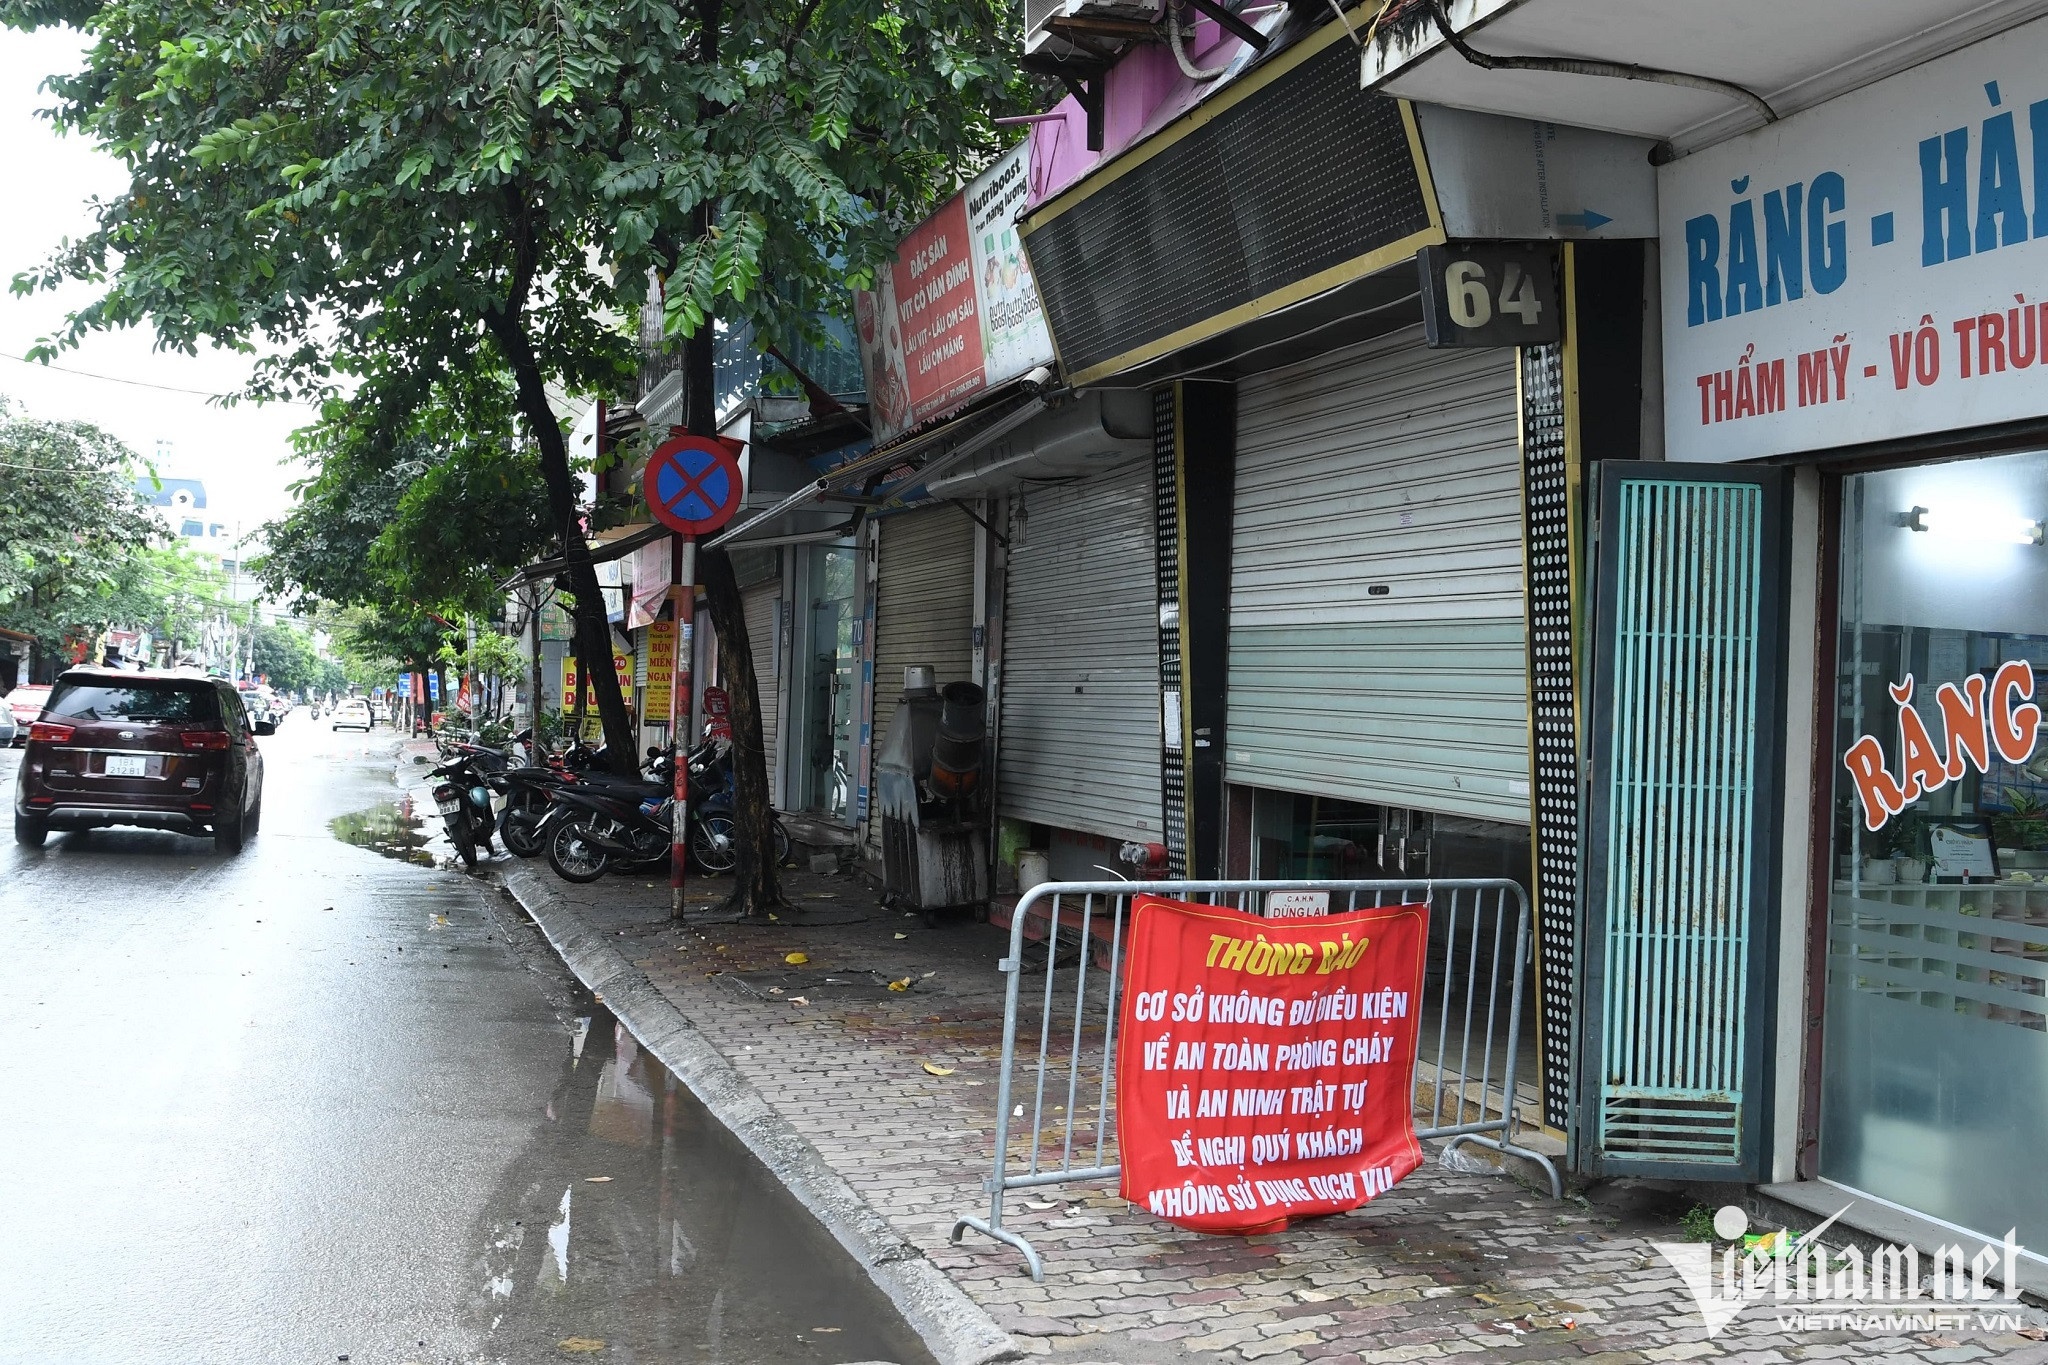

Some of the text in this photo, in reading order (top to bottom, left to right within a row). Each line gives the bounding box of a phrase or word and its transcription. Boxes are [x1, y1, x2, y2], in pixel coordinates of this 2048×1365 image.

[1535, 140, 1544, 158] DAYS
[1536, 160, 1546, 180] AFTER
[968, 156, 1021, 221] Nutriboost
[1004, 176, 1028, 208] lượng
[1539, 181, 1550, 229] INSTALLATION
[910, 234, 948, 280] ĐẶC SẢN
[1685, 171, 1847, 328] RĂNG
[1871, 211, 1894, 246] -
[900, 298, 913, 324] VỊT
[945, 257, 970, 292] ĐÌNH
[1444, 260, 1543, 328] 64
[904, 333, 917, 356] LẨU
[917, 328, 927, 349] VỊT
[931, 314, 946, 339] LẨU
[946, 308, 959, 329] OM
[958, 296, 974, 321] SẤU
[918, 334, 965, 375] LẨU OM MĂNG
[1697, 342, 1786, 426] THẨM
[1798, 332, 1851, 407] MỸ
[1863, 365, 1877, 378] -
[1889, 313, 1940, 390] VÔ
[652, 640, 671, 653] BÚN
[853, 619, 863, 643] 70
[647, 672, 672, 681] NGAN
[649, 653, 672, 667] MIẾN
[1844, 659, 2042, 832] RĂNG
[1205, 932, 1370, 977] THÔNG BÁO
[1135, 989, 1168, 1022] CƠ
[1171, 984, 1205, 1023] SỞ
[1208, 988, 1286, 1026] KHÔNG
[1289, 990, 1317, 1027] ĐỦ
[1361, 985, 1408, 1025] KIỆN
[1143, 1031, 1395, 1072] VỀ AN TOÀN PHÒNG CHÁY
[1166, 1079, 1368, 1119] VÀ AN NINH TRẬT TỰ
[1198, 1135, 1245, 1170] NGHỊ
[1251, 1127, 1292, 1163] QUÝ
[1296, 1124, 1363, 1160] KHÁCH
[1148, 1180, 1231, 1218] KHÔNG
[1228, 1174, 1257, 1211] SỬ
[1256, 1178, 1313, 1208] DỤNG
[1309, 1172, 1355, 1207] DỊCH
